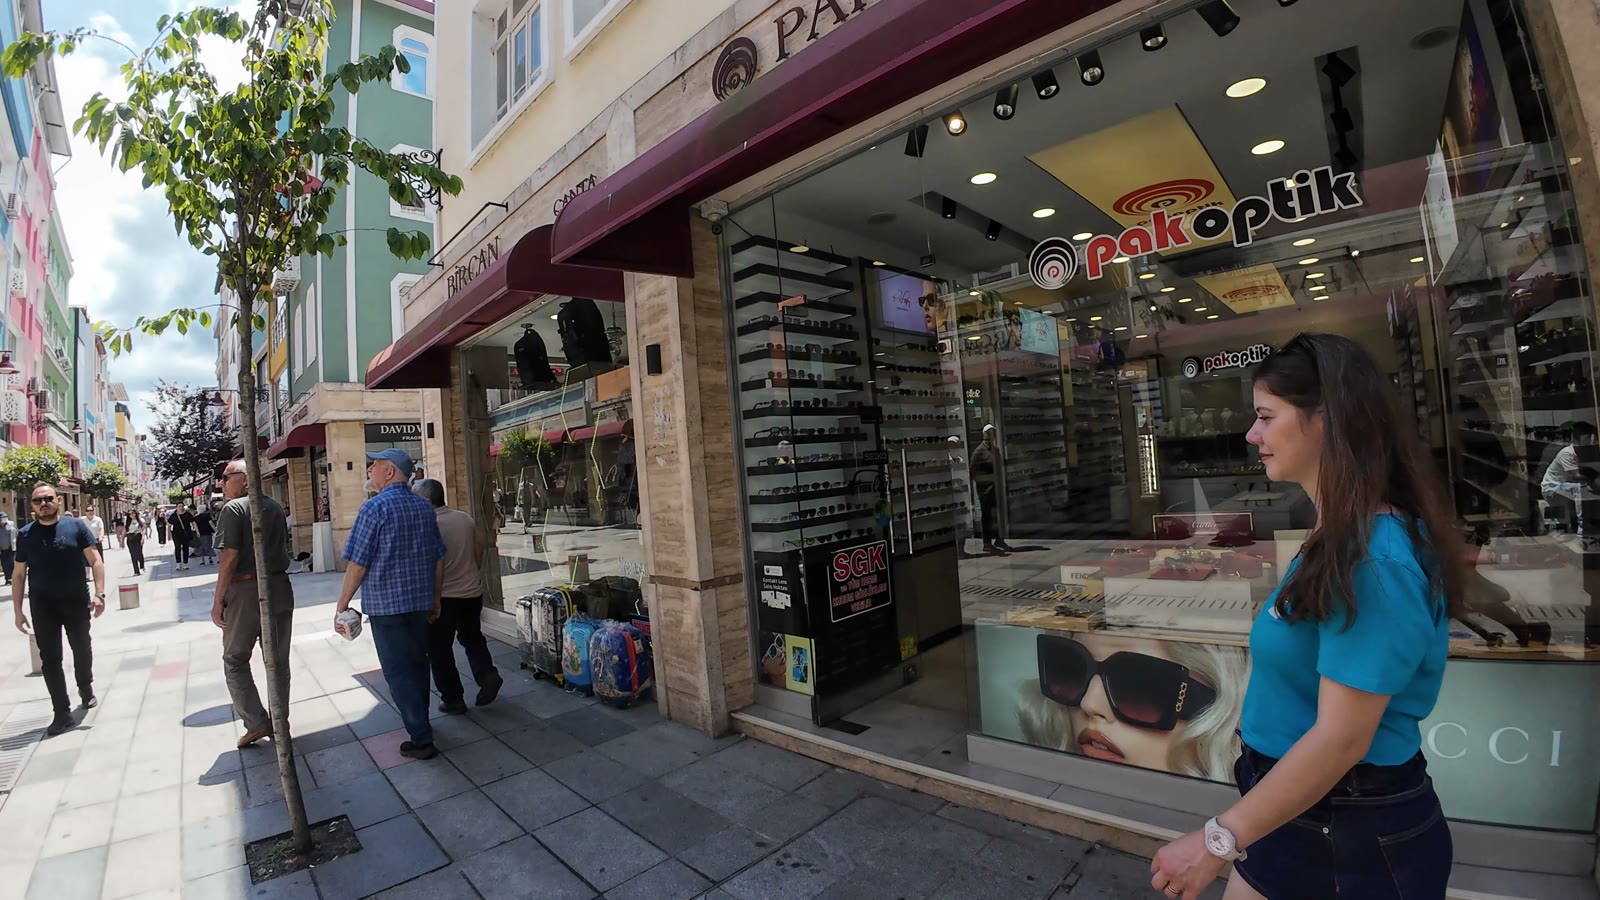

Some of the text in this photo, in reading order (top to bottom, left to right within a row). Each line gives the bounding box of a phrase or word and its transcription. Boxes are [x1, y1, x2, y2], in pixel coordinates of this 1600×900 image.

[773, 0, 868, 62] PA
[380, 424, 415, 434] DAVID
[833, 543, 886, 582] SGK
[1071, 572, 1090, 580] FEND
[1427, 721, 1562, 767] CCI
